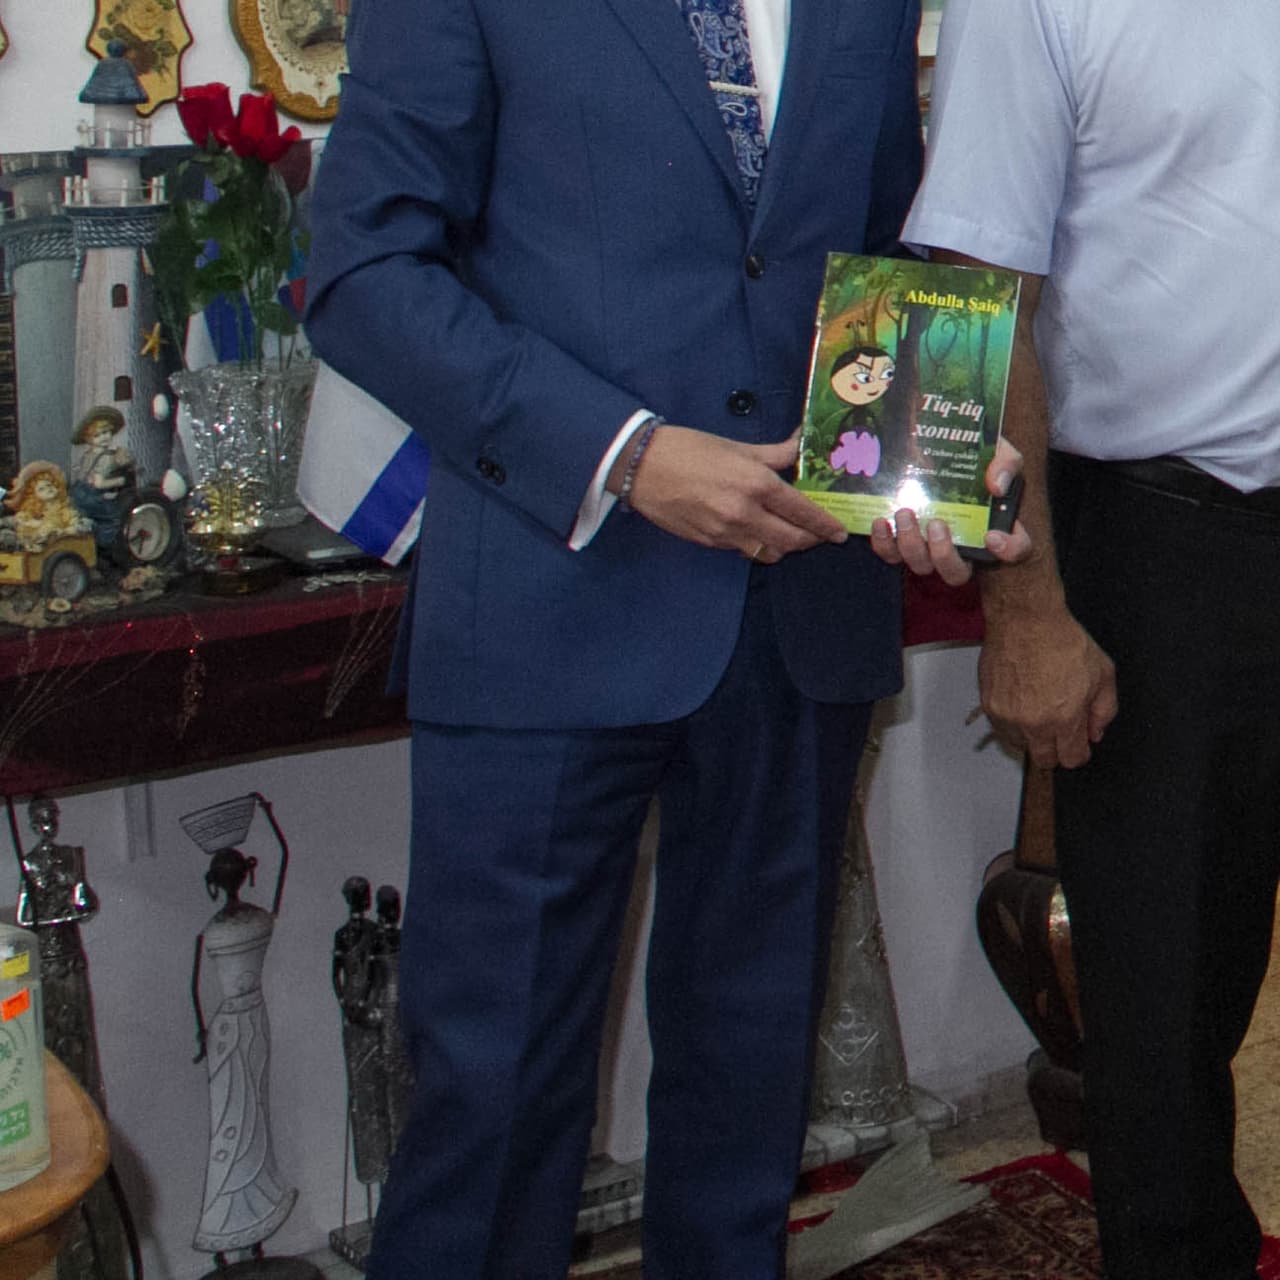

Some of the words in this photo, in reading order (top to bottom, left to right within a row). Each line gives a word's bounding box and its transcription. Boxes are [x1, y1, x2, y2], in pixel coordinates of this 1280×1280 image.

[905, 289, 965, 309] Abdulla
[921, 393, 984, 422] Tiq-tiq
[911, 423, 981, 444] xonum
